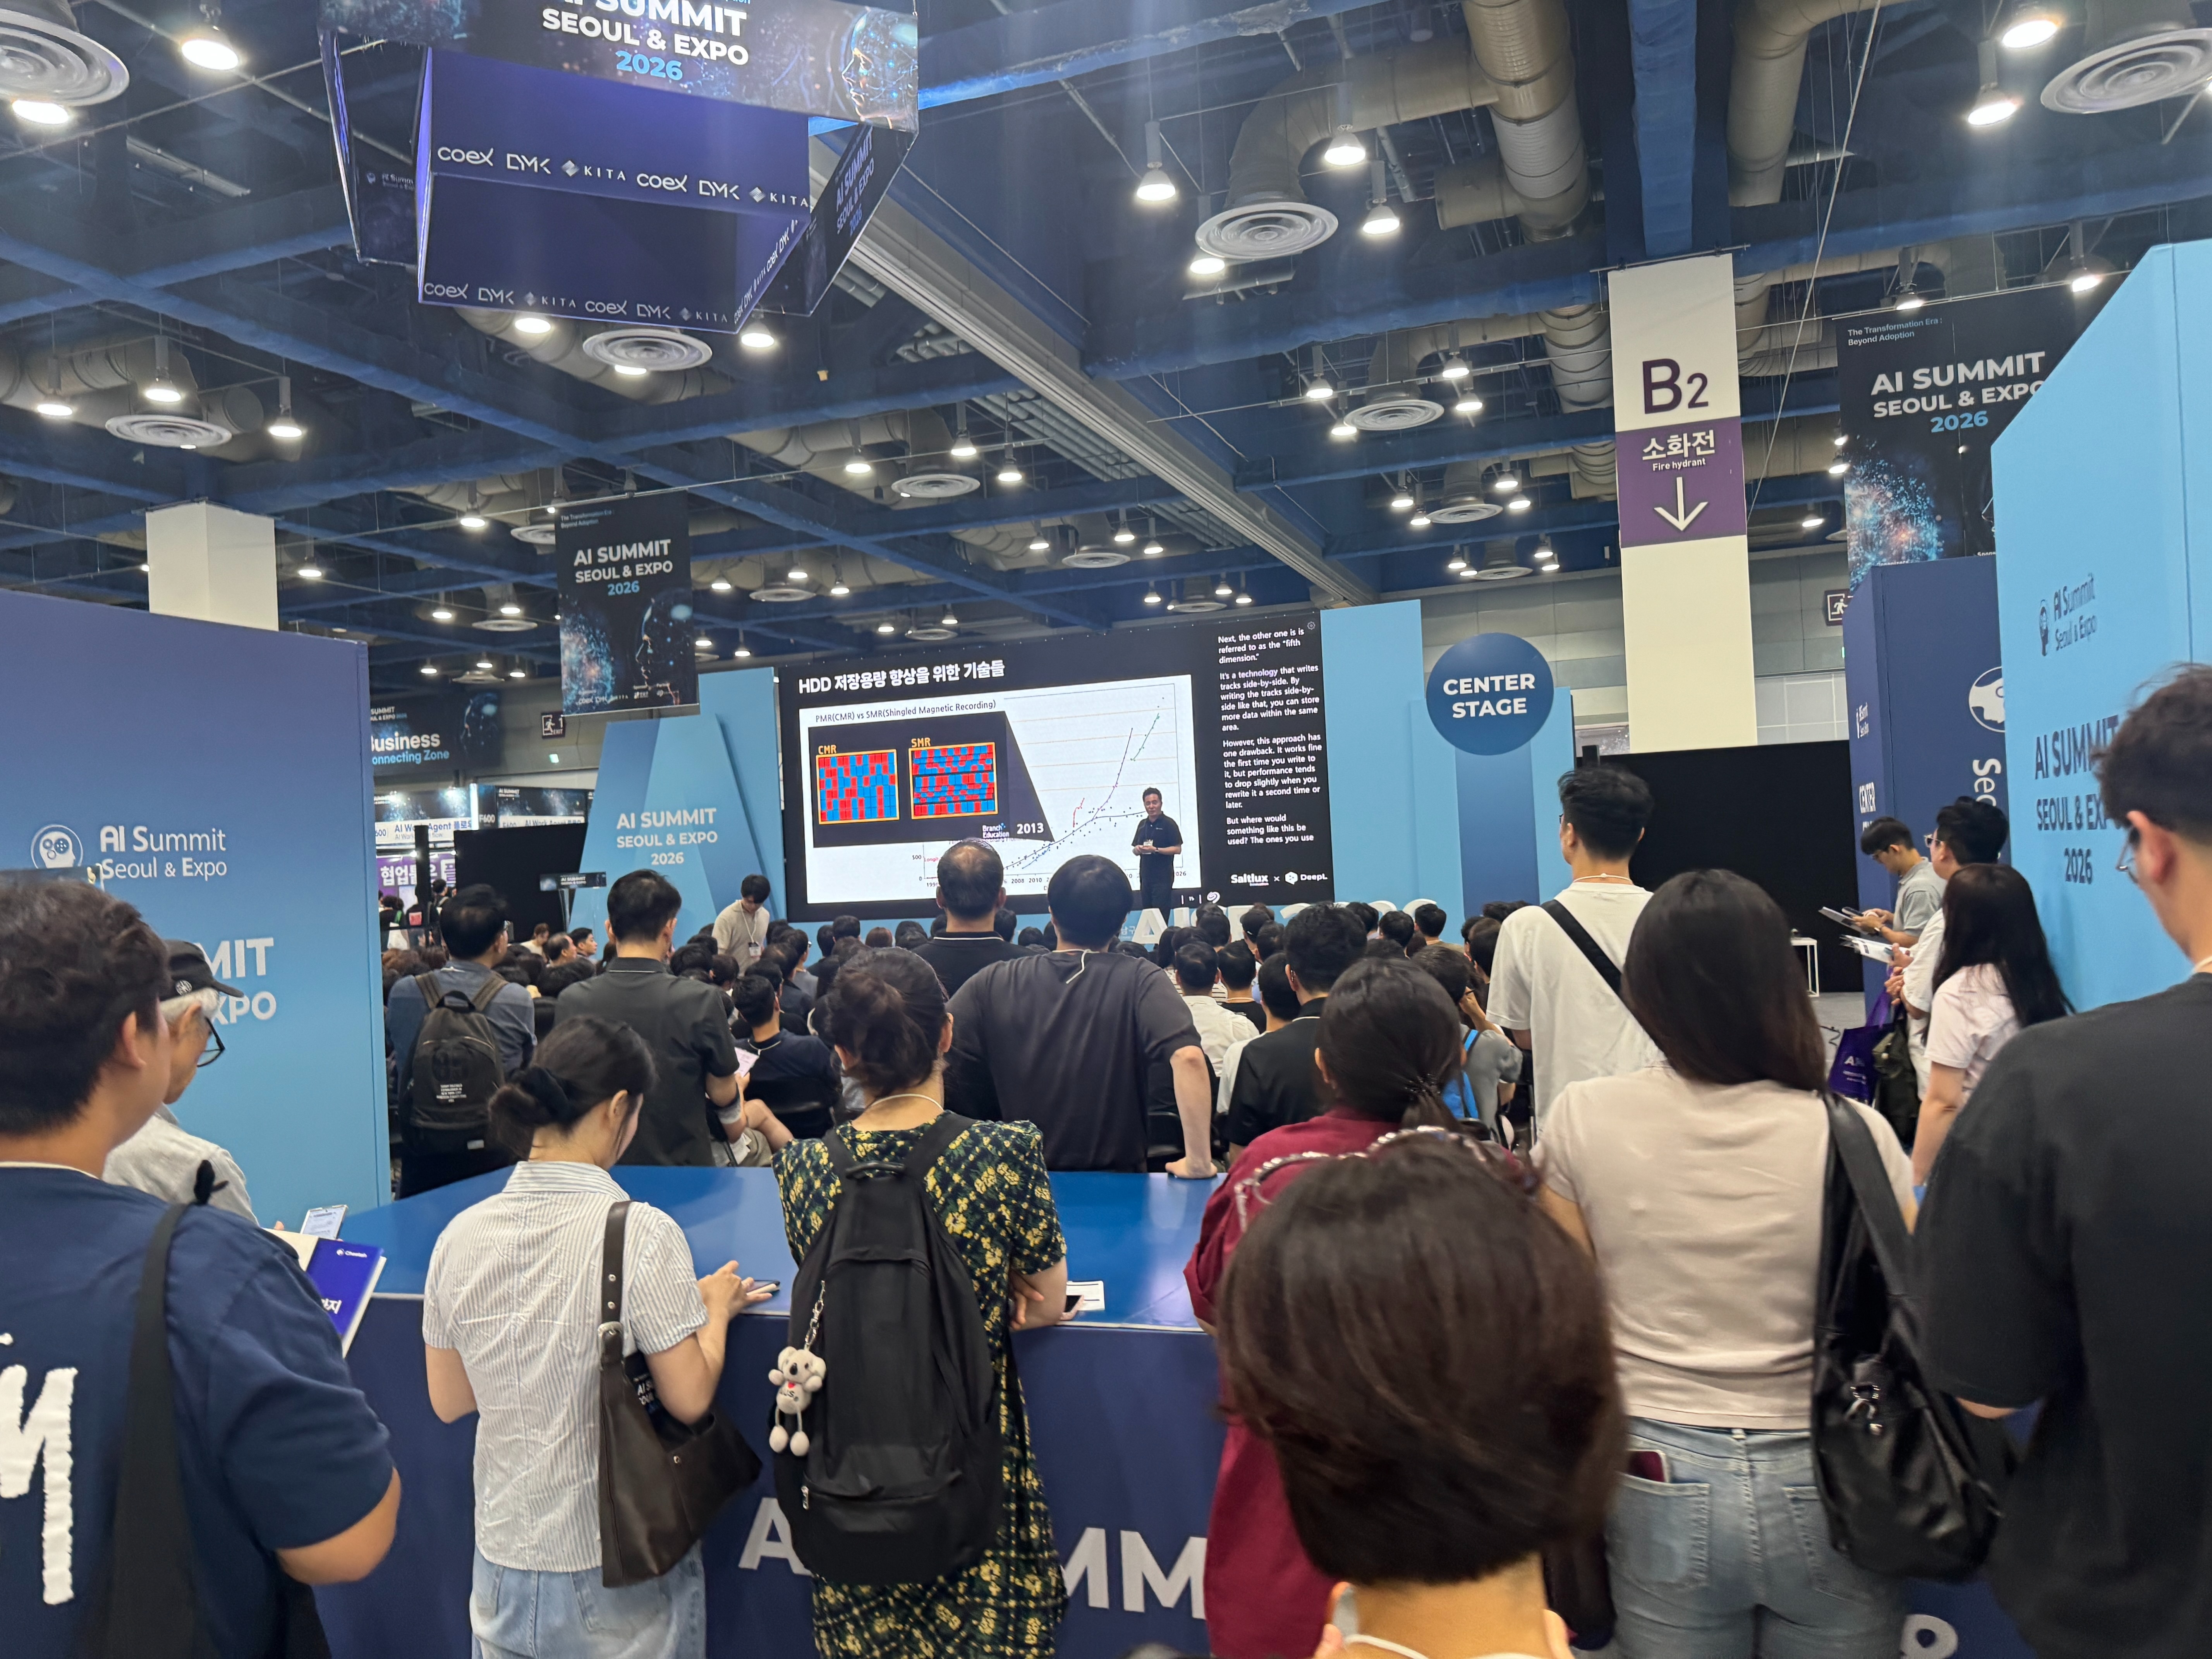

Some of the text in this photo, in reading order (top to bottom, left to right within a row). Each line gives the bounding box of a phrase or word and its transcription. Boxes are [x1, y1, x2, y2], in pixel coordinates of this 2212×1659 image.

[543, 8, 749, 65] SEOUL & EXPO
[615, 50, 683, 80] 2026
[437, 147, 493, 167] coex
[584, 165, 626, 182] KITA
[636, 172, 687, 193] coex
[770, 192, 809, 208] KITA
[424, 282, 468, 299] coex
[542, 295, 577, 308] KITA
[585, 300, 627, 316] coex
[696, 311, 727, 323] KITA
[1848, 328, 1863, 337] The
[1864, 320, 1924, 334] Transformation
[1848, 331, 1914, 346] Beyond Adoption
[1870, 351, 2045, 395] AI SUMMIT
[1643, 358, 1708, 414] B2
[1874, 394, 1952, 417] SEOUL
[1958, 390, 1975, 407] &
[1930, 411, 1988, 433] 2026
[1642, 429, 1715, 460] 소화전
[1653, 457, 1705, 471] Fire hydrant
[574, 539, 671, 566] AI SUMMIT
[575, 560, 673, 583] SEOUL & EXPO
[607, 580, 640, 596] 2026
[1218, 635, 1236, 643] Next,
[1252, 632, 1272, 640] other
[1218, 644, 1246, 654] referred
[799, 659, 1005, 694] HDD 저장용량 향상을 위한 기술들
[1238, 669, 1278, 678] technology
[1297, 665, 1319, 673] writes
[1443, 673, 1535, 696] CENTER
[1220, 685, 1314, 701] writing the tracks side-by-
[816, 711, 855, 723] PMR(CMR)
[866, 707, 916, 718] SMR(Shingled
[919, 704, 953, 714] Magnetic
[956, 699, 996, 711] Recording)
[1452, 697, 1527, 718] STAGE
[559, 717, 563, 728] 1
[911, 738, 931, 747] SMR
[1223, 739, 1255, 747] However,
[1257, 737, 1270, 745] this
[1272, 734, 1305, 745] approach
[424, 749, 449, 761] Zone
[818, 745, 837, 755] CMR
[2035, 734, 2049, 780] AI
[1233, 769, 1245, 778] but
[1247, 766, 1293, 778] performance
[1295, 764, 1315, 773] tends
[1225, 790, 1249, 799] rewrite
[1266, 787, 1291, 796] second
[1293, 786, 1310, 794] time
[479, 814, 495, 823] F600
[617, 808, 716, 830] AI SUMMIT
[1241, 816, 1262, 824] where
[1264, 814, 1286, 823] would
[2037, 795, 2083, 831] SEOUL &
[428, 823, 451, 832] Agent
[982, 824, 1002, 832] Branch
[982, 830, 1010, 838] Education
[1017, 823, 1044, 835] 2013
[100, 825, 226, 852] AI Summit
[617, 831, 718, 848] SEOUL & EXPO
[1228, 836, 1248, 845] used?
[1285, 835, 1298, 844] you
[651, 852, 684, 865] 2026
[2064, 848, 2093, 884] 2026
[101, 856, 227, 881] Seoul & Expo
[1230, 873, 1269, 884] Saltlux
